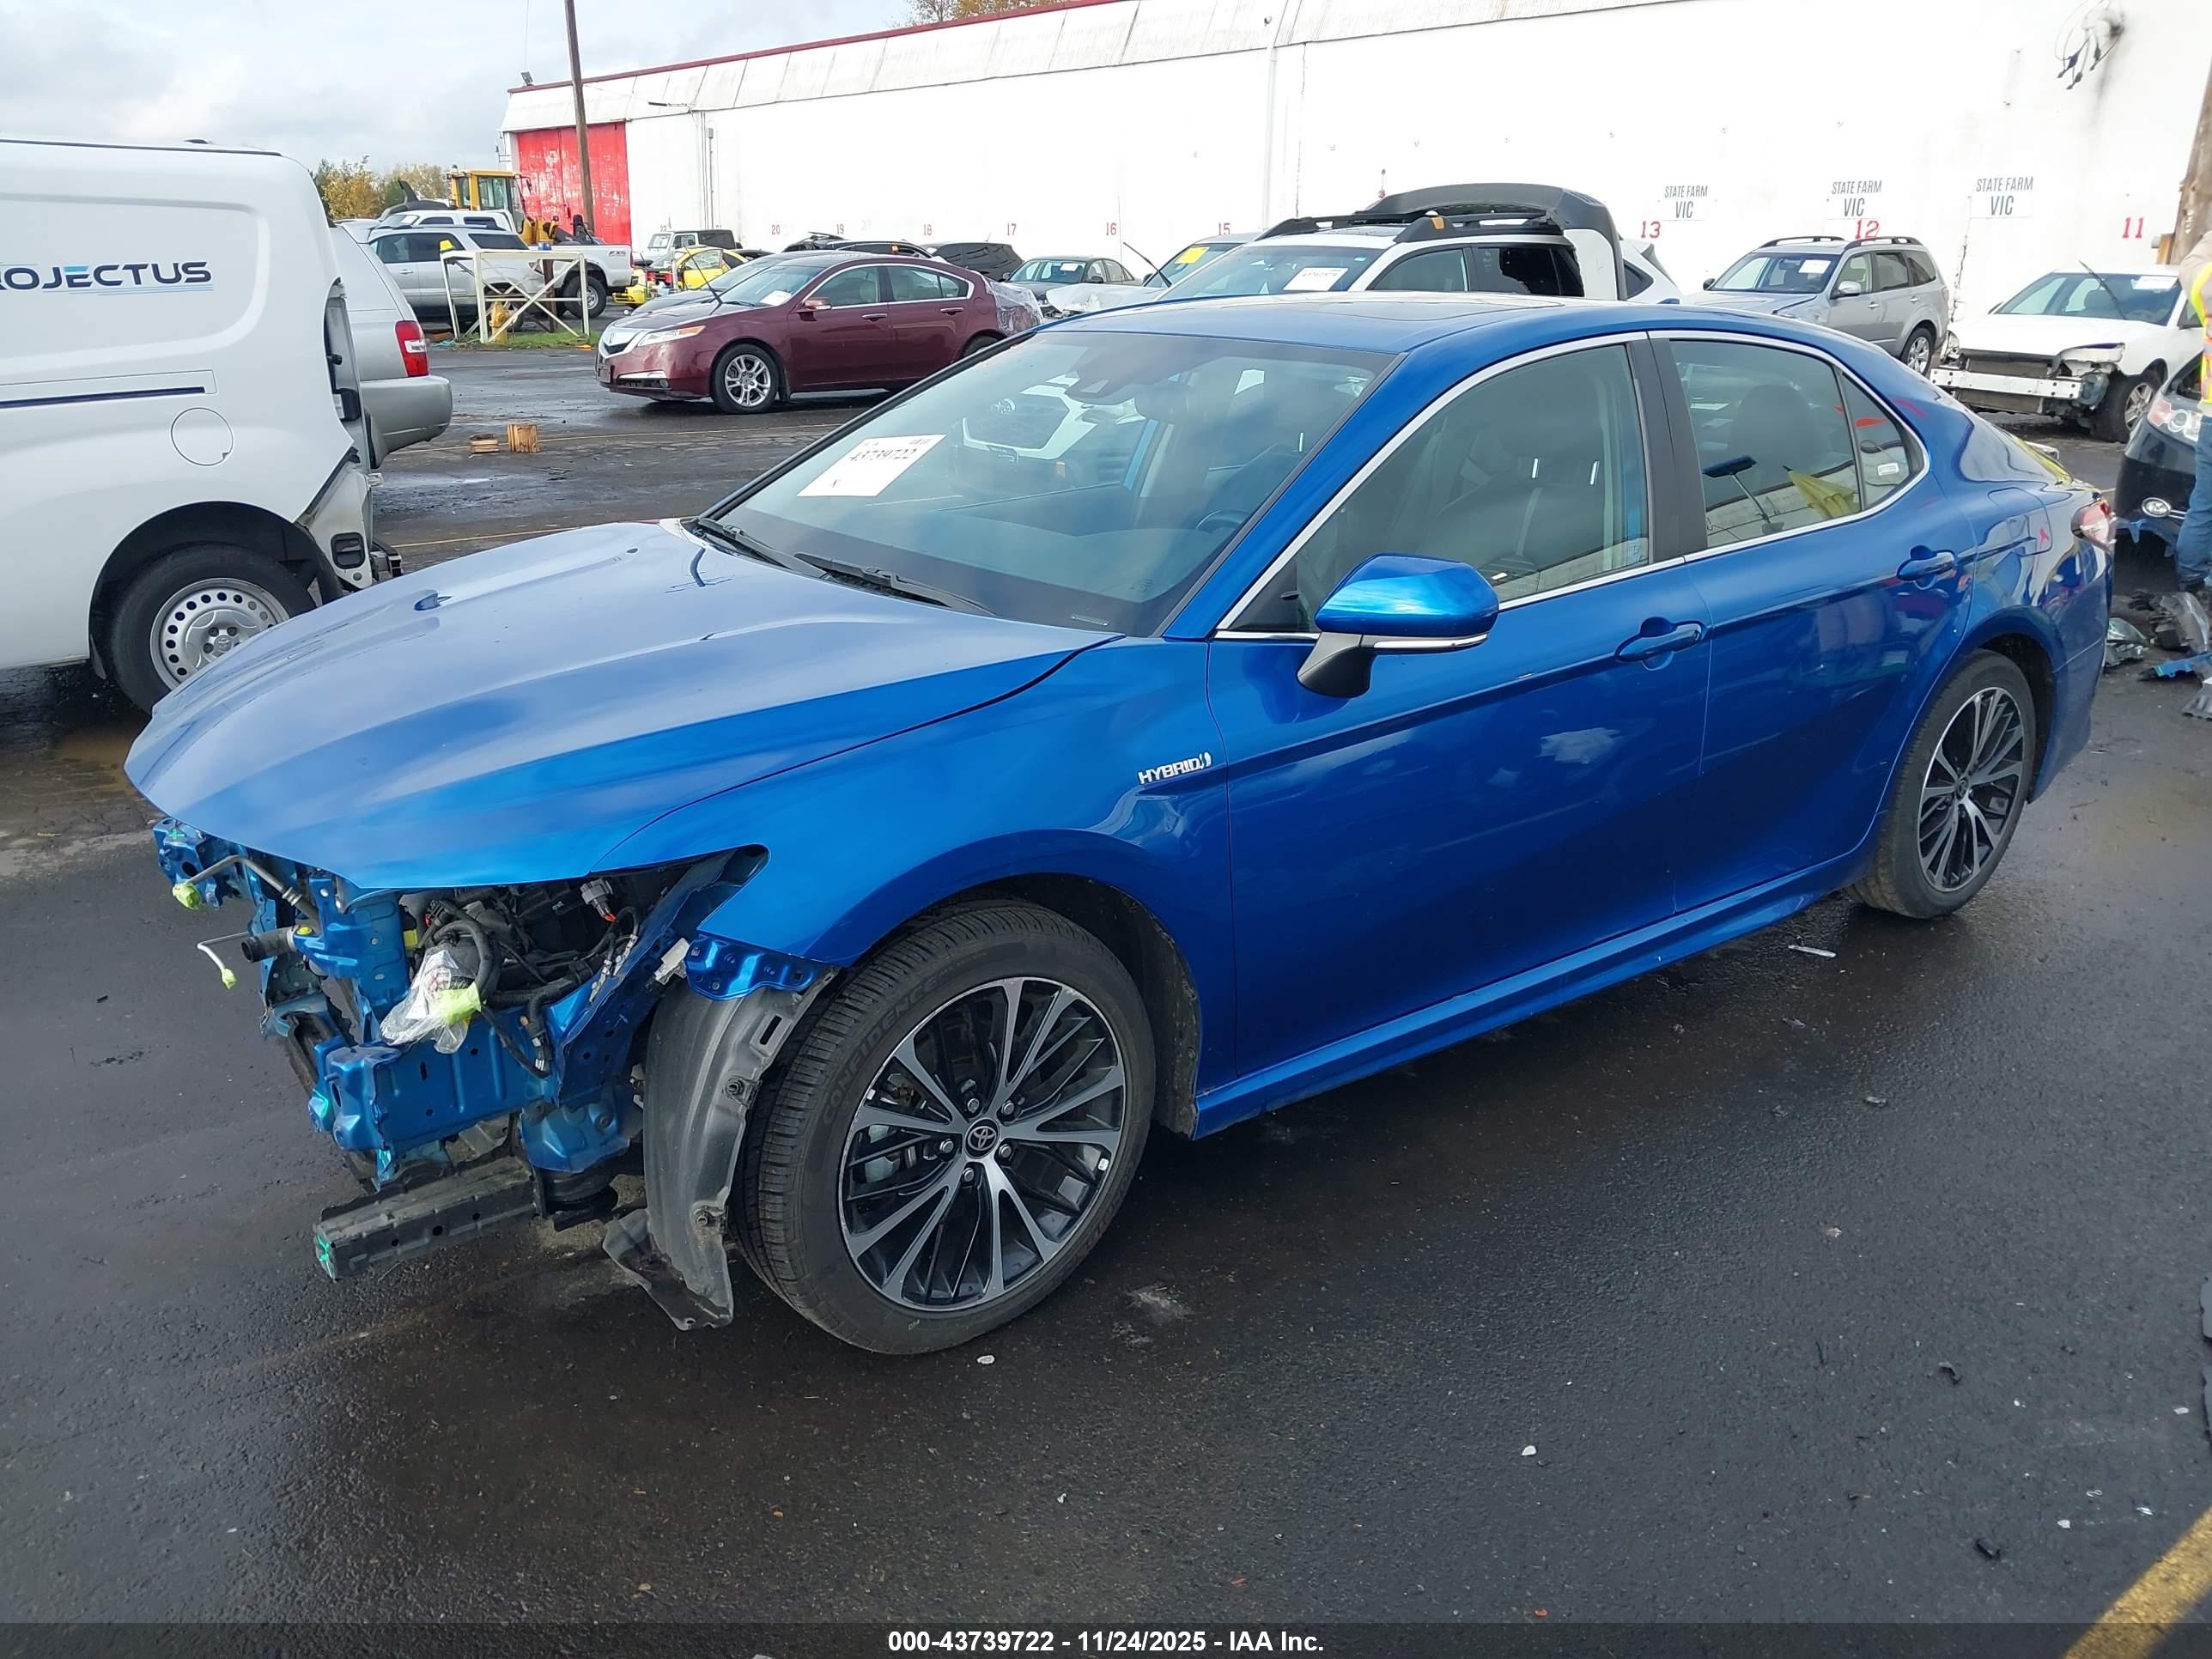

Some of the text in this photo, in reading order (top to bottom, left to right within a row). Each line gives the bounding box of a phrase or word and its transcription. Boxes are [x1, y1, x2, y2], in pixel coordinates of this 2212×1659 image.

[1664, 185, 1708, 198] STATE FARM
[1832, 179, 1882, 195] STATE FARM
[1976, 176, 2034, 192] STATE FARM
[1675, 200, 1694, 218] VIC
[1844, 198, 1865, 216] VIC
[1990, 195, 2014, 216] VIC
[771, 224, 781, 235] 20
[836, 223, 845, 235] 19
[923, 223, 933, 236] 18
[1006, 222, 1018, 236] 17
[1105, 222, 1117, 236] 16
[1218, 222, 1231, 236] 15
[1640, 220, 1662, 239] 13
[1855, 219, 1880, 240] 12
[2122, 216, 2145, 239] 11
[0, 261, 212, 290] OJECTUS
[1138, 757, 1204, 785] HYBRID
